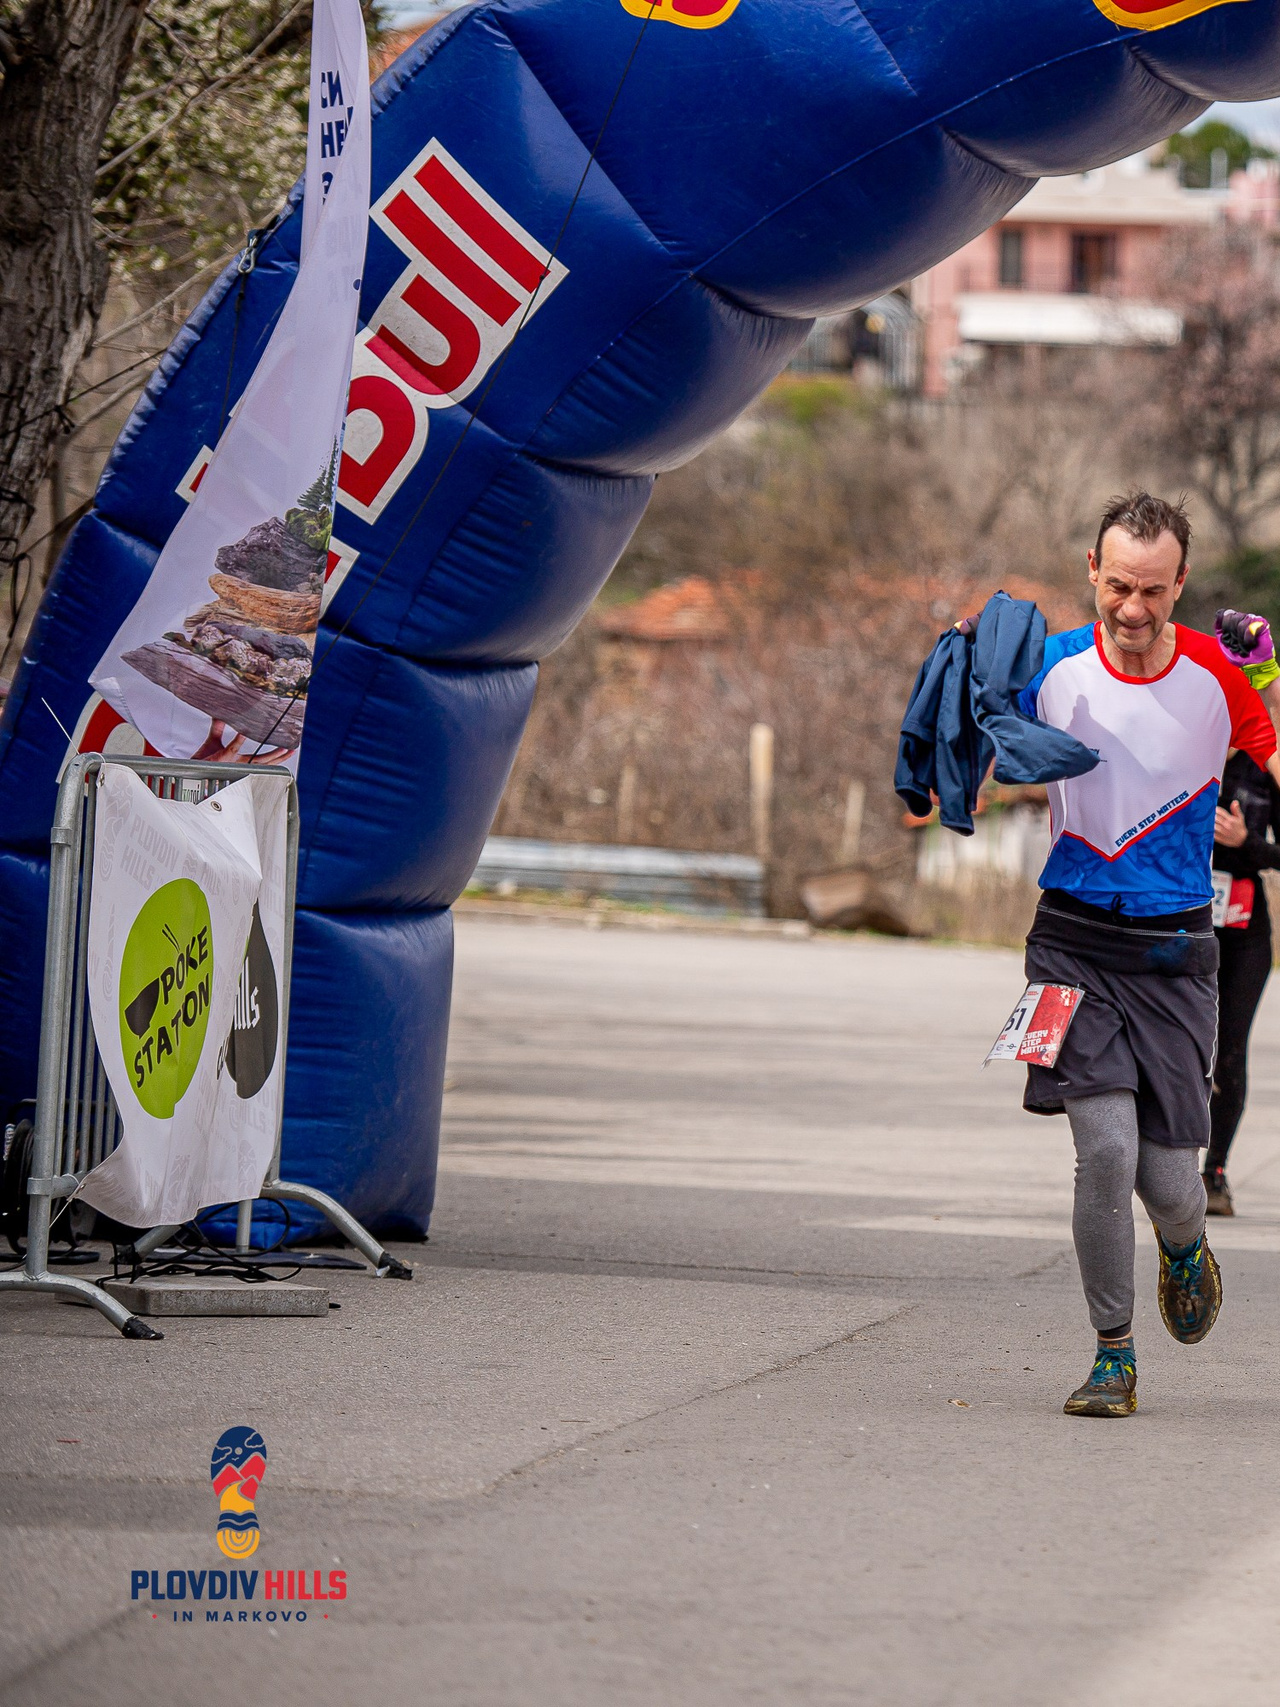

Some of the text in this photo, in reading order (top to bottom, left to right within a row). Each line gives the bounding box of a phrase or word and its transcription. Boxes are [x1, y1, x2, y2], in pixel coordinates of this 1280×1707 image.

[1115, 790, 1190, 848] EVERY STEP MATTERS
[160, 925, 208, 1006] POKE
